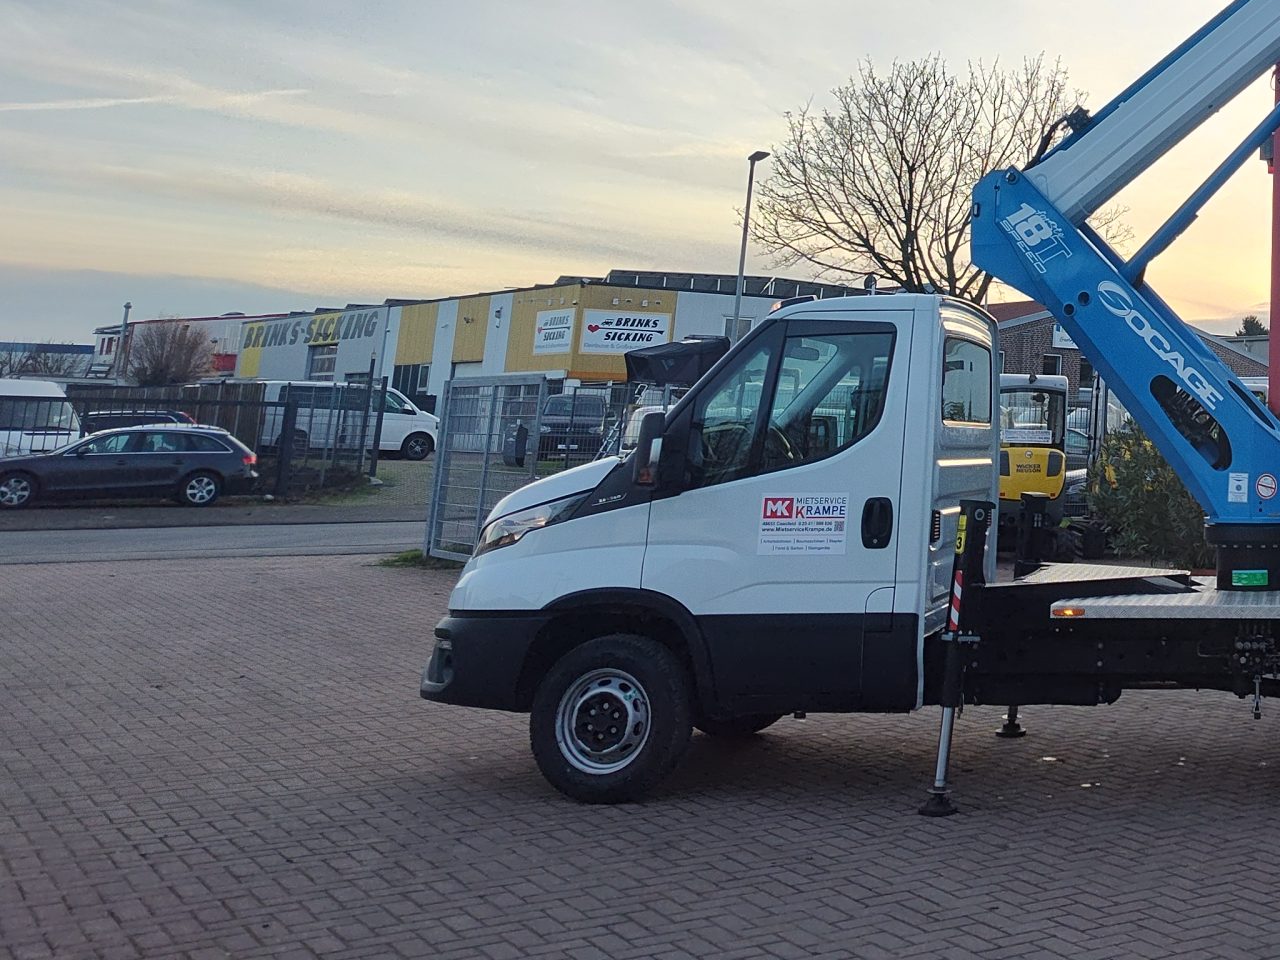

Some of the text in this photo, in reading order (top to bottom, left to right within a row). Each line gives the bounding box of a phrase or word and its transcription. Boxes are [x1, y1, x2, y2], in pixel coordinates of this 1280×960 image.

[1000, 219, 1047, 274] SPEED
[615, 317, 660, 329] BRINKS
[603, 331, 654, 343] SICKING
[1097, 280, 1225, 411] SOCAGE
[796, 497, 847, 505] MIETSERVICE
[766, 500, 791, 517] MK
[795, 505, 846, 519] KRAMPE
[956, 536, 963, 550] 3
